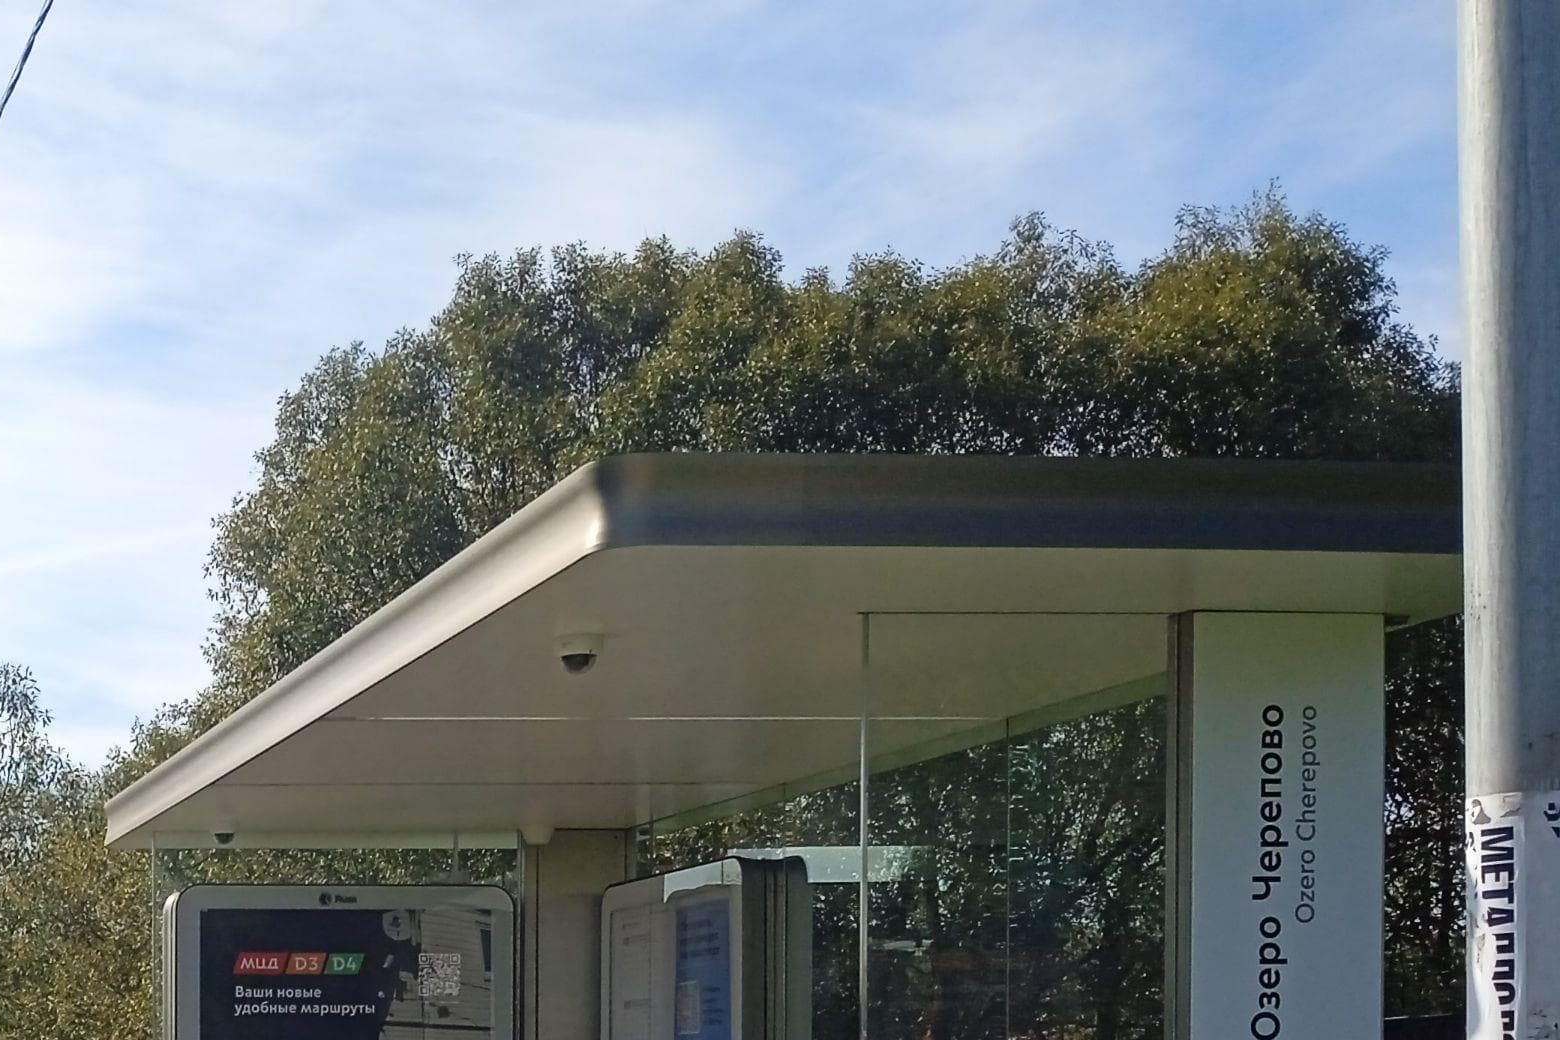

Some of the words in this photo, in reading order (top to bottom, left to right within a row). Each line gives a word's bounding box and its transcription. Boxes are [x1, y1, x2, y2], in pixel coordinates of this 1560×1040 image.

[1295, 705, 1321, 842] Cherepovo
[1251, 703, 1289, 901] Черепово
[1294, 849, 1316, 924] Ozero
[240, 957, 279, 970] МЦД
[294, 957, 319, 971] D3
[332, 957, 357, 971] D4
[234, 1001, 297, 1017] удобные
[300, 1003, 376, 1017] маршруты
[235, 985, 273, 998] Ваши
[277, 987, 322, 998] новые
